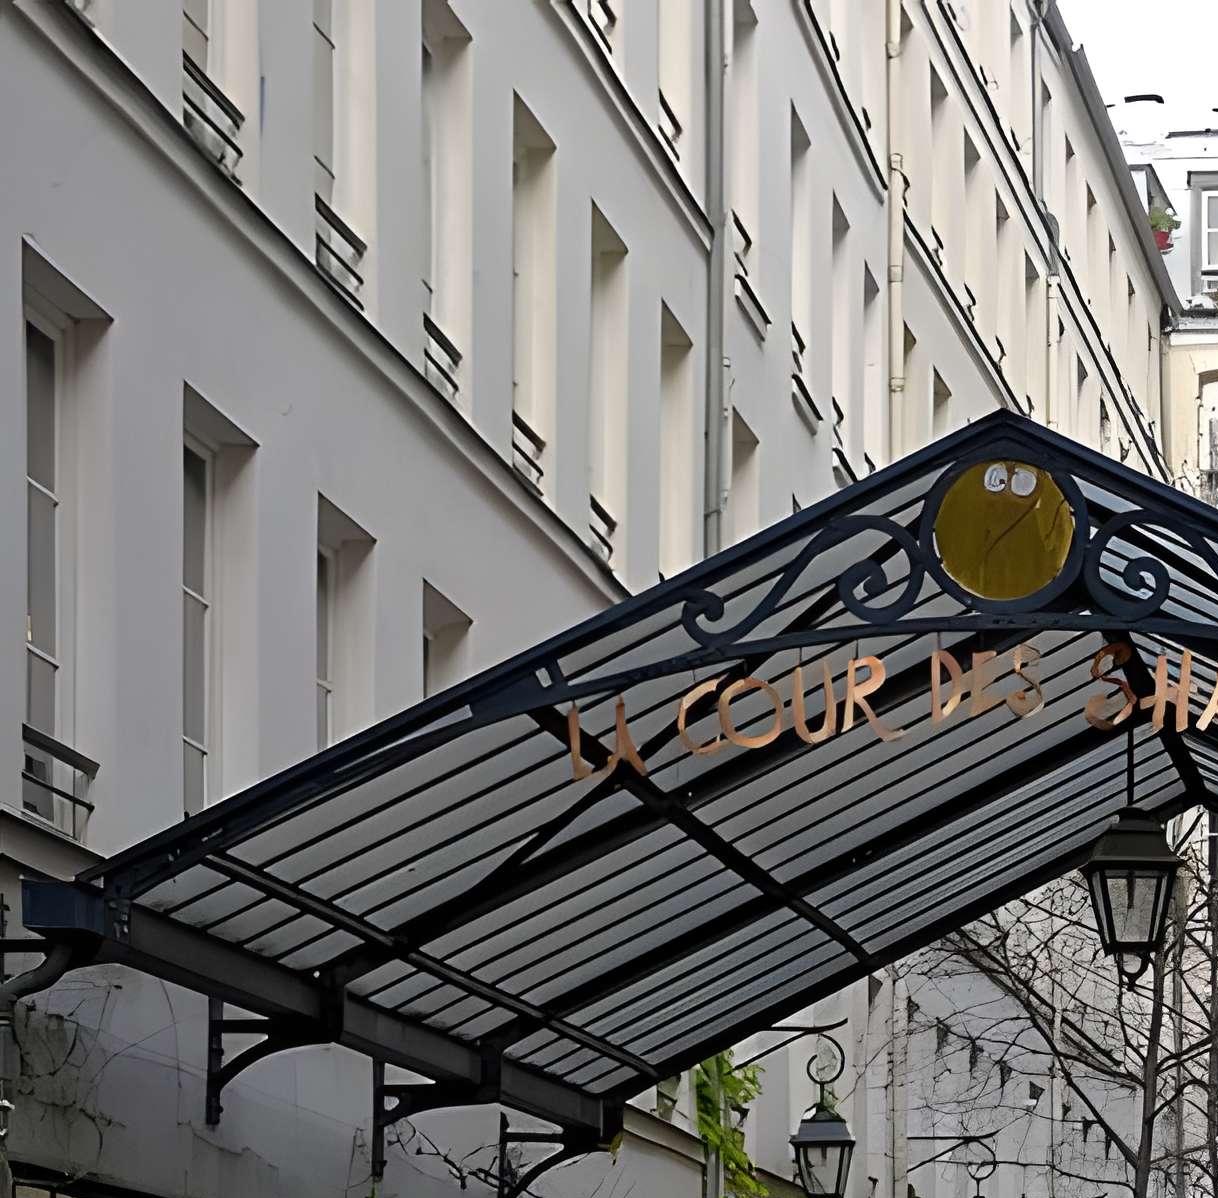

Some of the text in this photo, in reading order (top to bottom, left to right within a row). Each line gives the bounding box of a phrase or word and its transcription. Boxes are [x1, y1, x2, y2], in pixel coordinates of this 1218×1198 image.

[568, 697, 648, 780] LA
[678, 655, 906, 755] COUR
[931, 645, 1046, 728] DES
